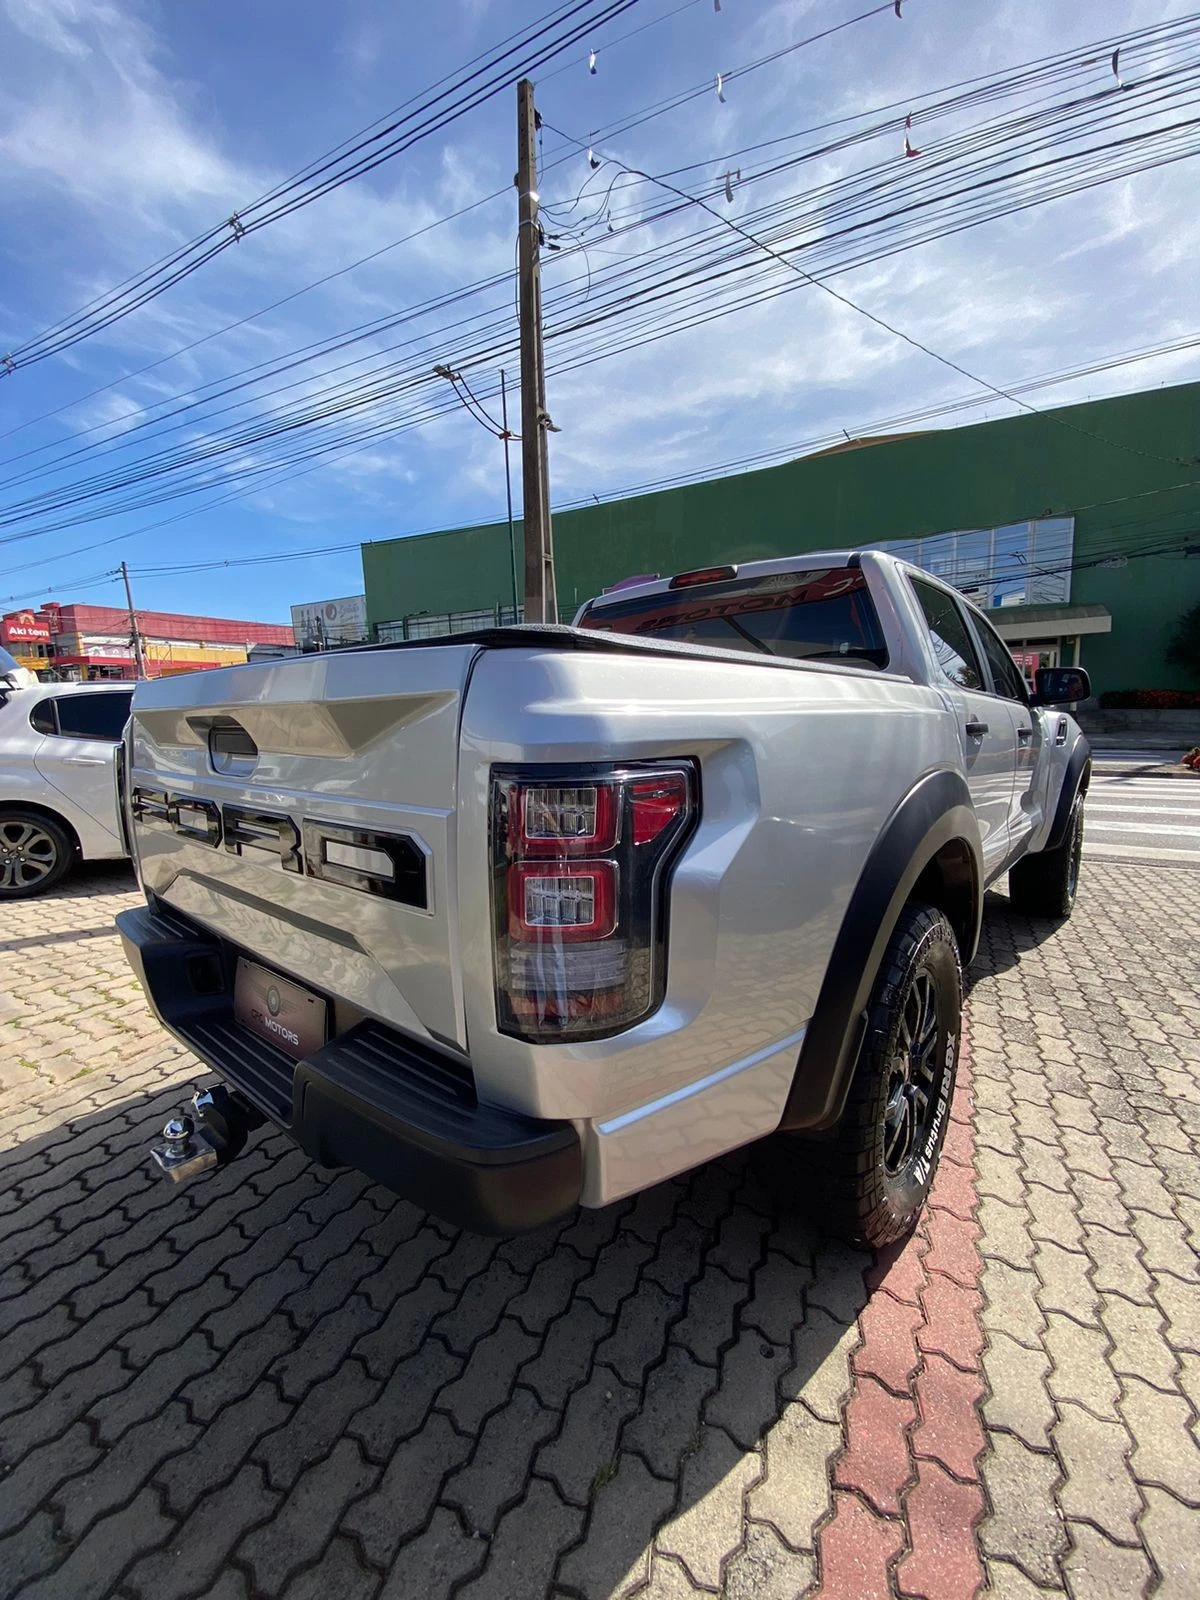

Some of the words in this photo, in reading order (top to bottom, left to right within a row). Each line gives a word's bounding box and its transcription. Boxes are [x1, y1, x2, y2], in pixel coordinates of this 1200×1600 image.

[9, 626, 27, 636] Aki
[27, 628, 50, 637] tem
[132, 786, 428, 910] FORD
[264, 1016, 299, 1046] MOTORS
[940, 1031, 956, 1099] XBRI
[924, 1098, 947, 1159] Brutus
[913, 1156, 931, 1186] T/A
